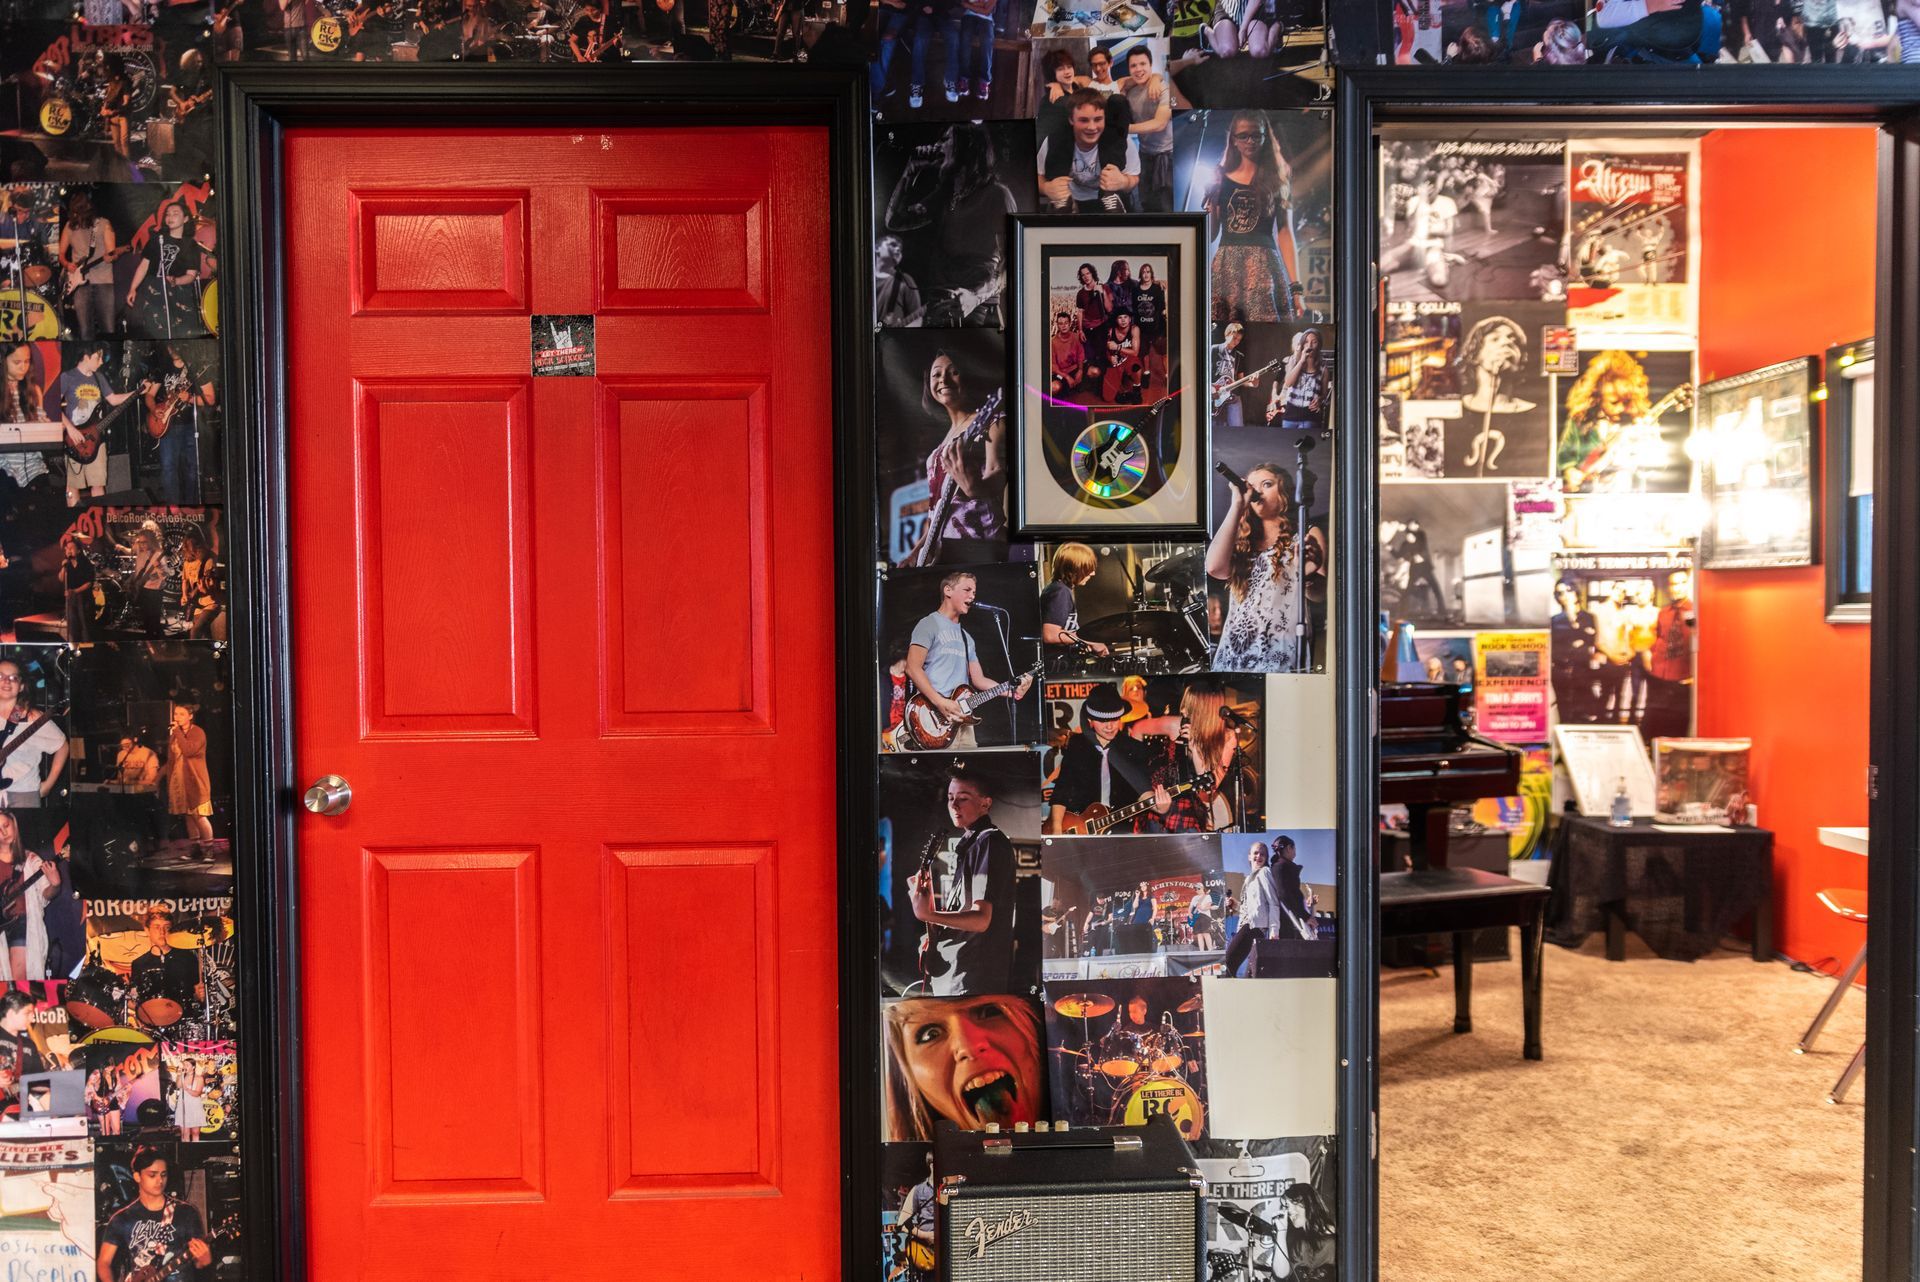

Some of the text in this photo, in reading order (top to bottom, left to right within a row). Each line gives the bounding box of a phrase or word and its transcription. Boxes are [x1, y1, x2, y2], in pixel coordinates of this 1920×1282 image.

[1418, 302, 1461, 313] COLLAR
[106, 512, 205, 523] DelcoRockSchool.com
[1555, 557, 1596, 569] STONE
[1600, 557, 1648, 569] TEMPLE
[1155, 1089, 1174, 1097] THERE
[1175, 1088, 1184, 1096] BE
[0, 1150, 79, 1163] LLER'S
[1232, 1181, 1275, 1198] THERE
[965, 1209, 1038, 1258] Fender
